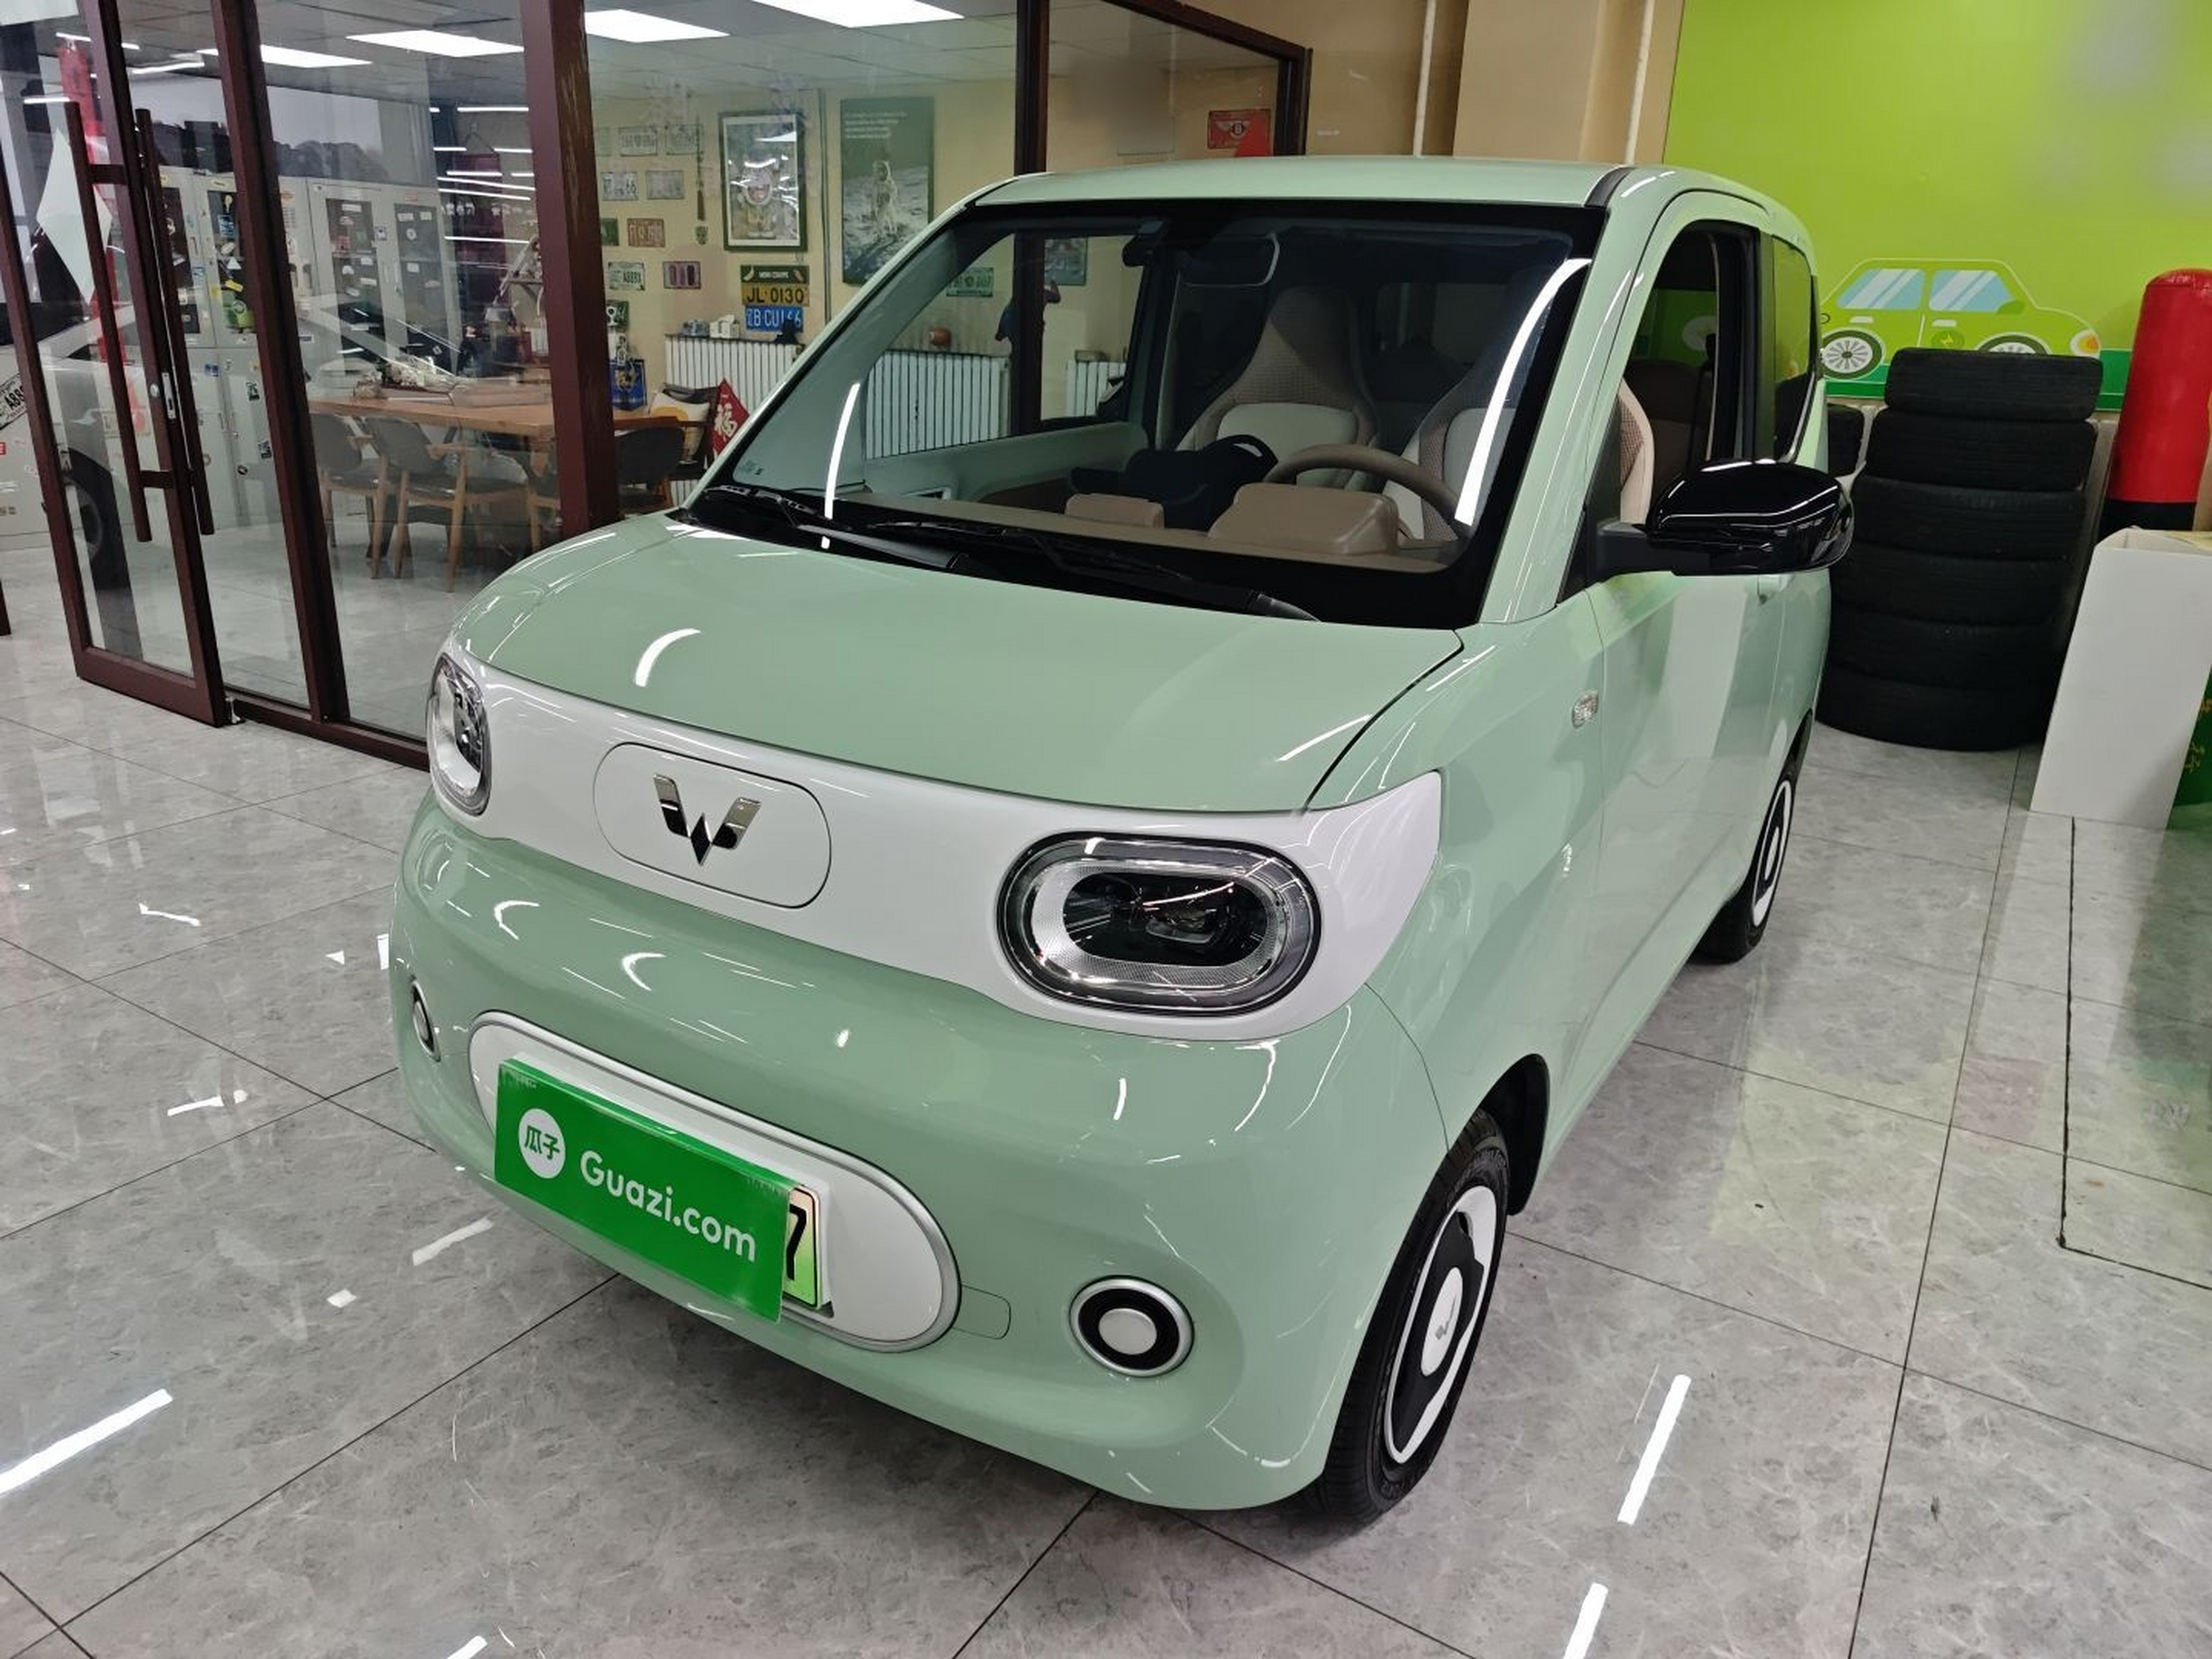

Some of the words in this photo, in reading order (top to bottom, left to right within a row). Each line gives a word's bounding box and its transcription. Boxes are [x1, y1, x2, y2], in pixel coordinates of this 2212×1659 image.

[524, 1124, 562, 1161] 瓜子
[580, 1150, 756, 1262] Guazi.com
[785, 1203, 808, 1281] 7
